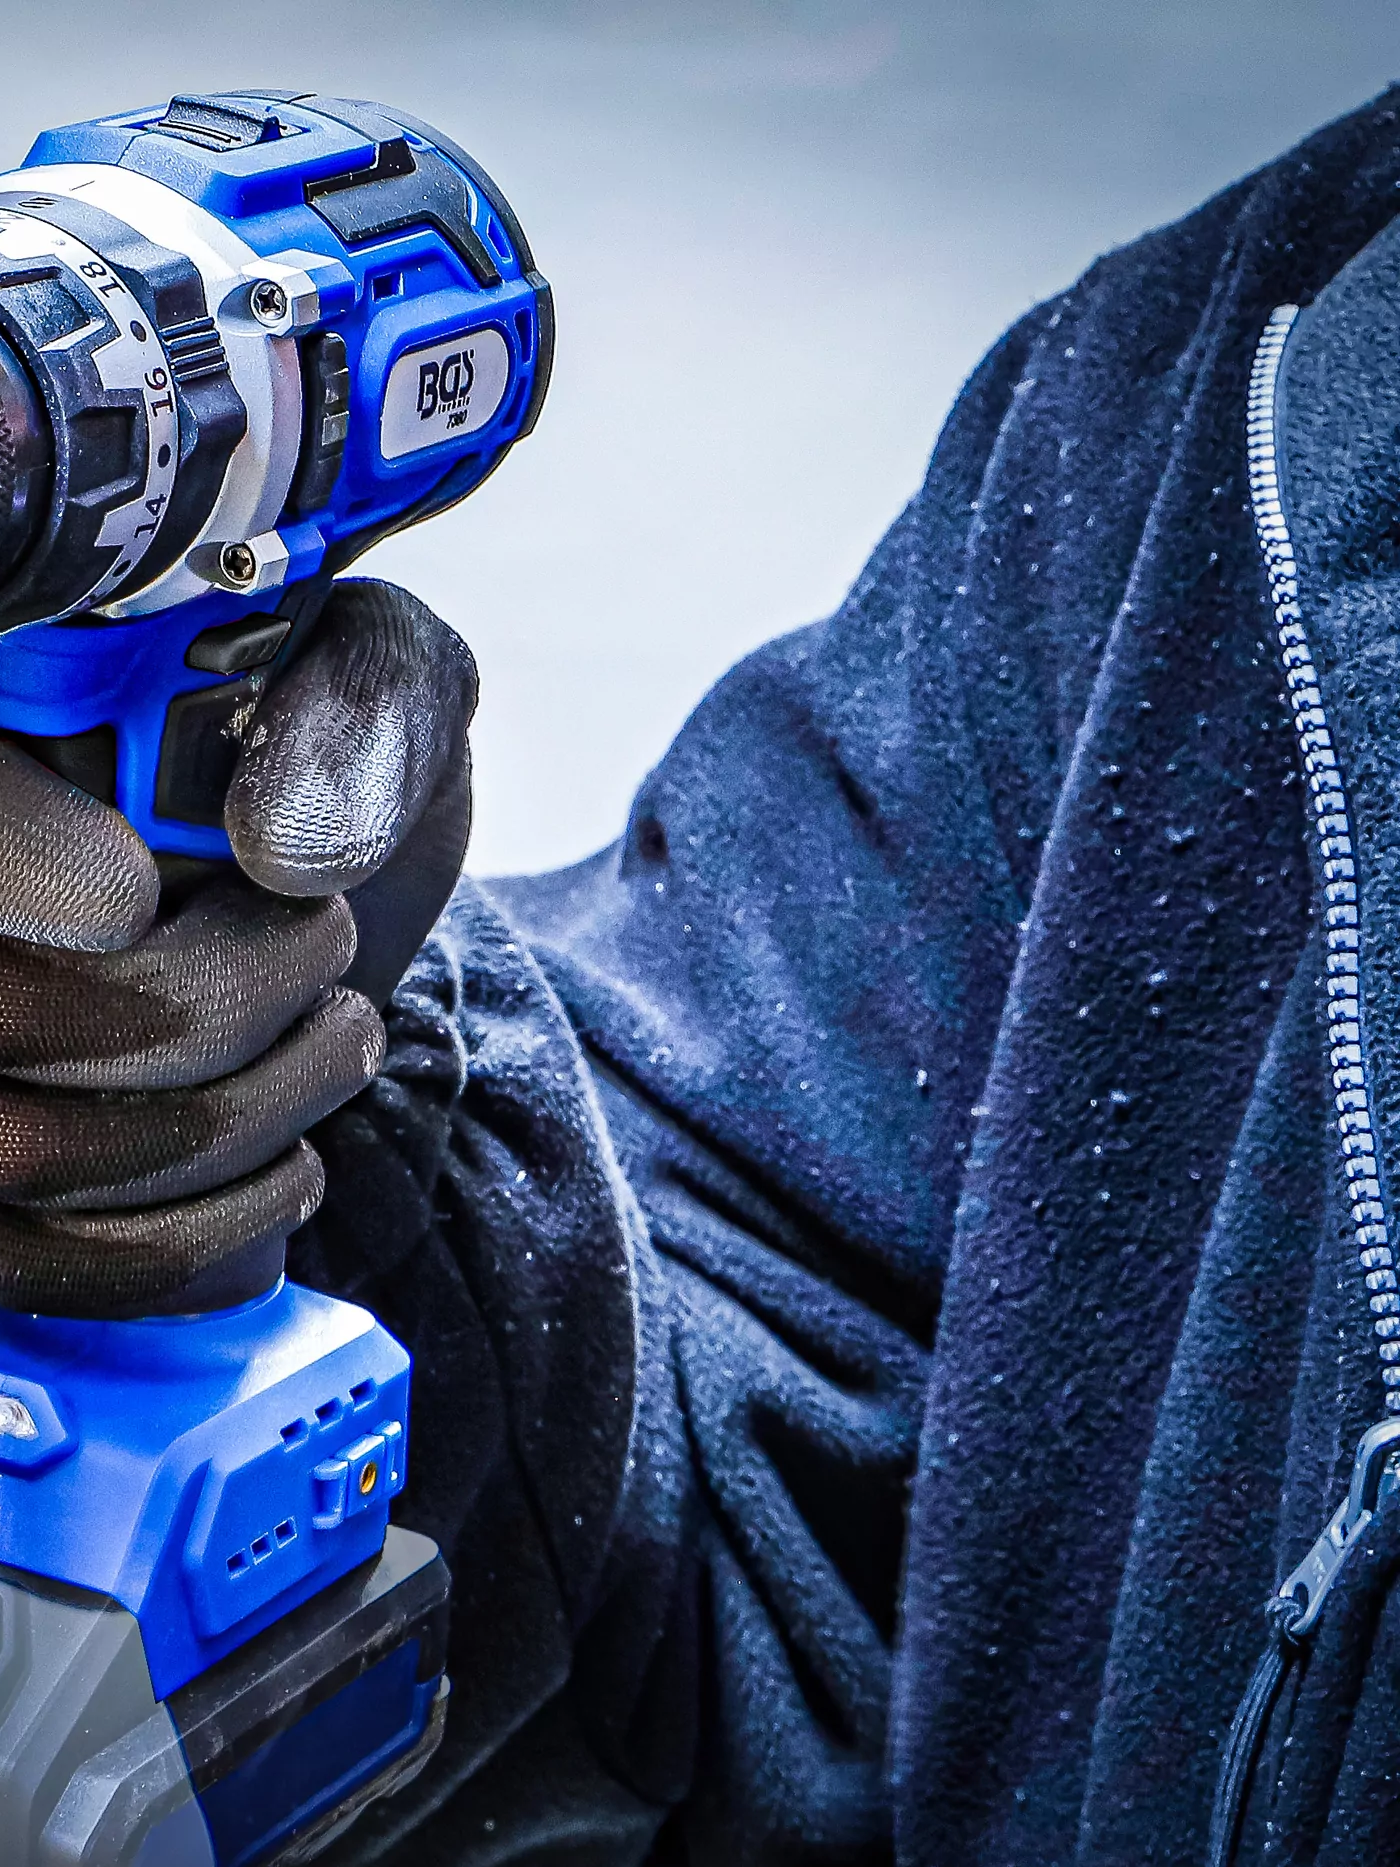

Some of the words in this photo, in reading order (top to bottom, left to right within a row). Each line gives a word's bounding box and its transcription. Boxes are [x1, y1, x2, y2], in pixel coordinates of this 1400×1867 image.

[79, 261, 126, 298] 18
[144, 366, 173, 418] 16
[416, 348, 475, 421] BGS
[134, 494, 167, 539] 14
